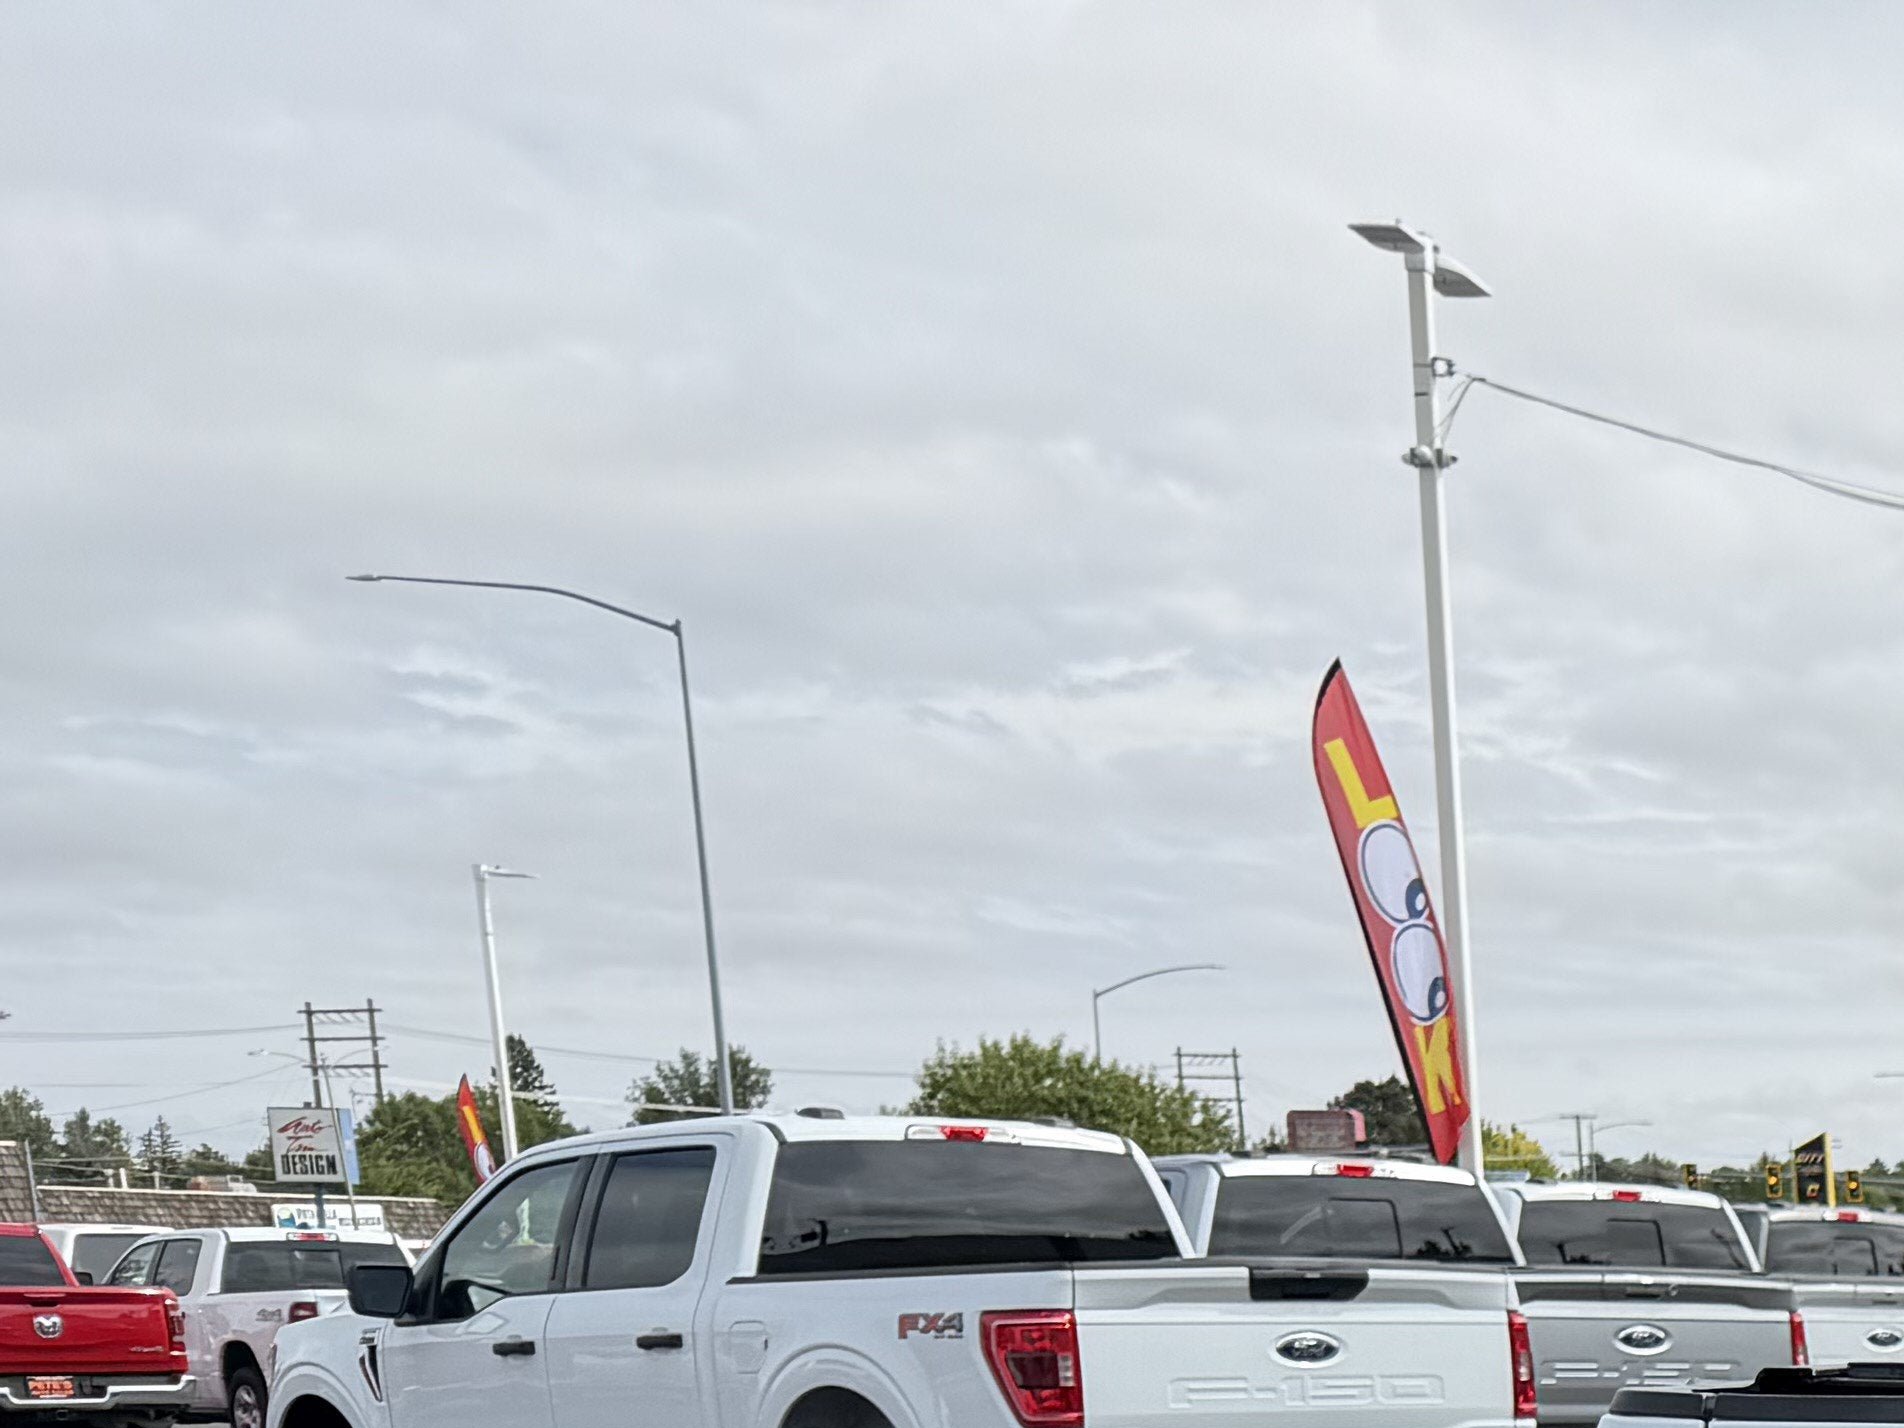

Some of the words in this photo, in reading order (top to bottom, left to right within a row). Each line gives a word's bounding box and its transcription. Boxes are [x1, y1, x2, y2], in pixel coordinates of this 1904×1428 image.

[281, 1154, 338, 1175] DESIGN
[898, 1313, 963, 1339] FX4
[1168, 1375, 1445, 1409] F-150
